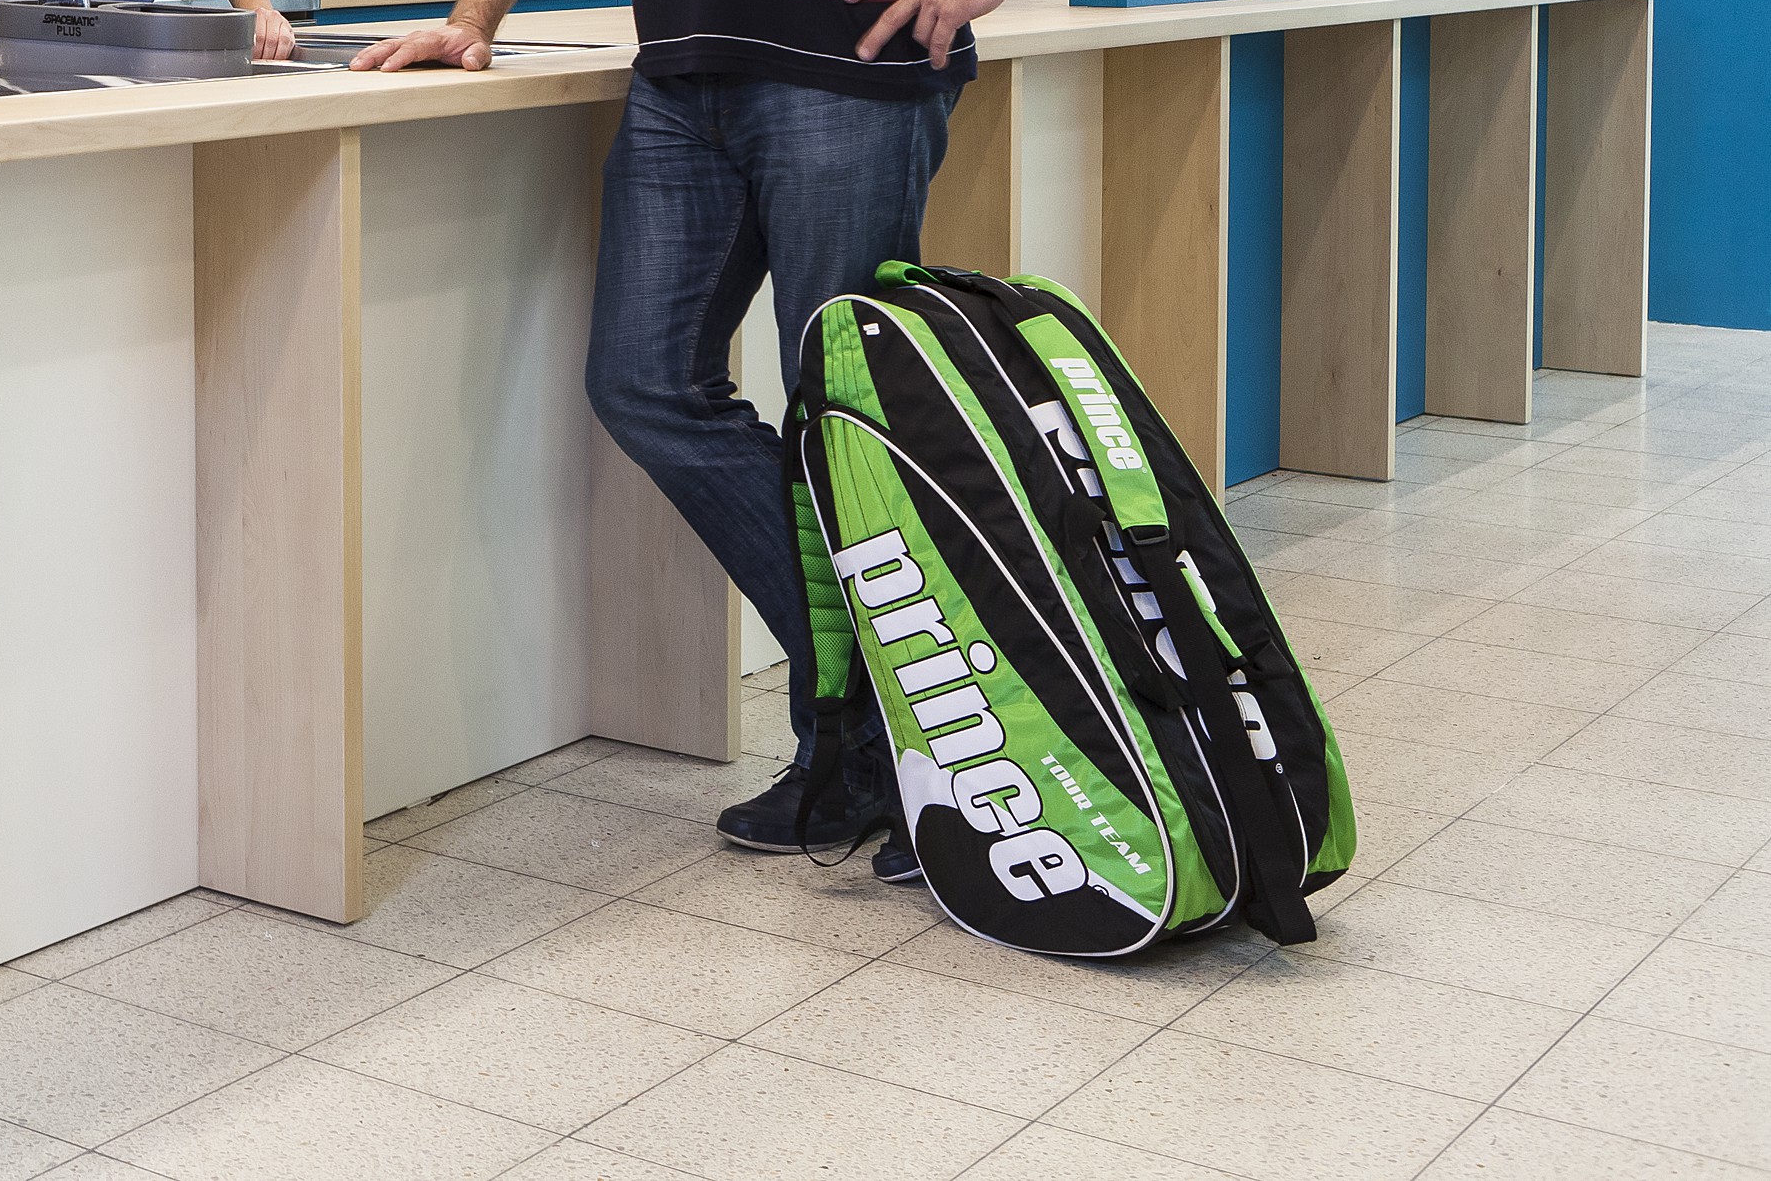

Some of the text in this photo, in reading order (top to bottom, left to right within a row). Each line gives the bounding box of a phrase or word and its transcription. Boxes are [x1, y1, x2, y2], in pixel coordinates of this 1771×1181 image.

[57, 25, 82, 37] PLUS
[1049, 358, 1142, 470] prince
[833, 527, 1089, 902] prince
[1040, 751, 1151, 875] TOUR TEAM
